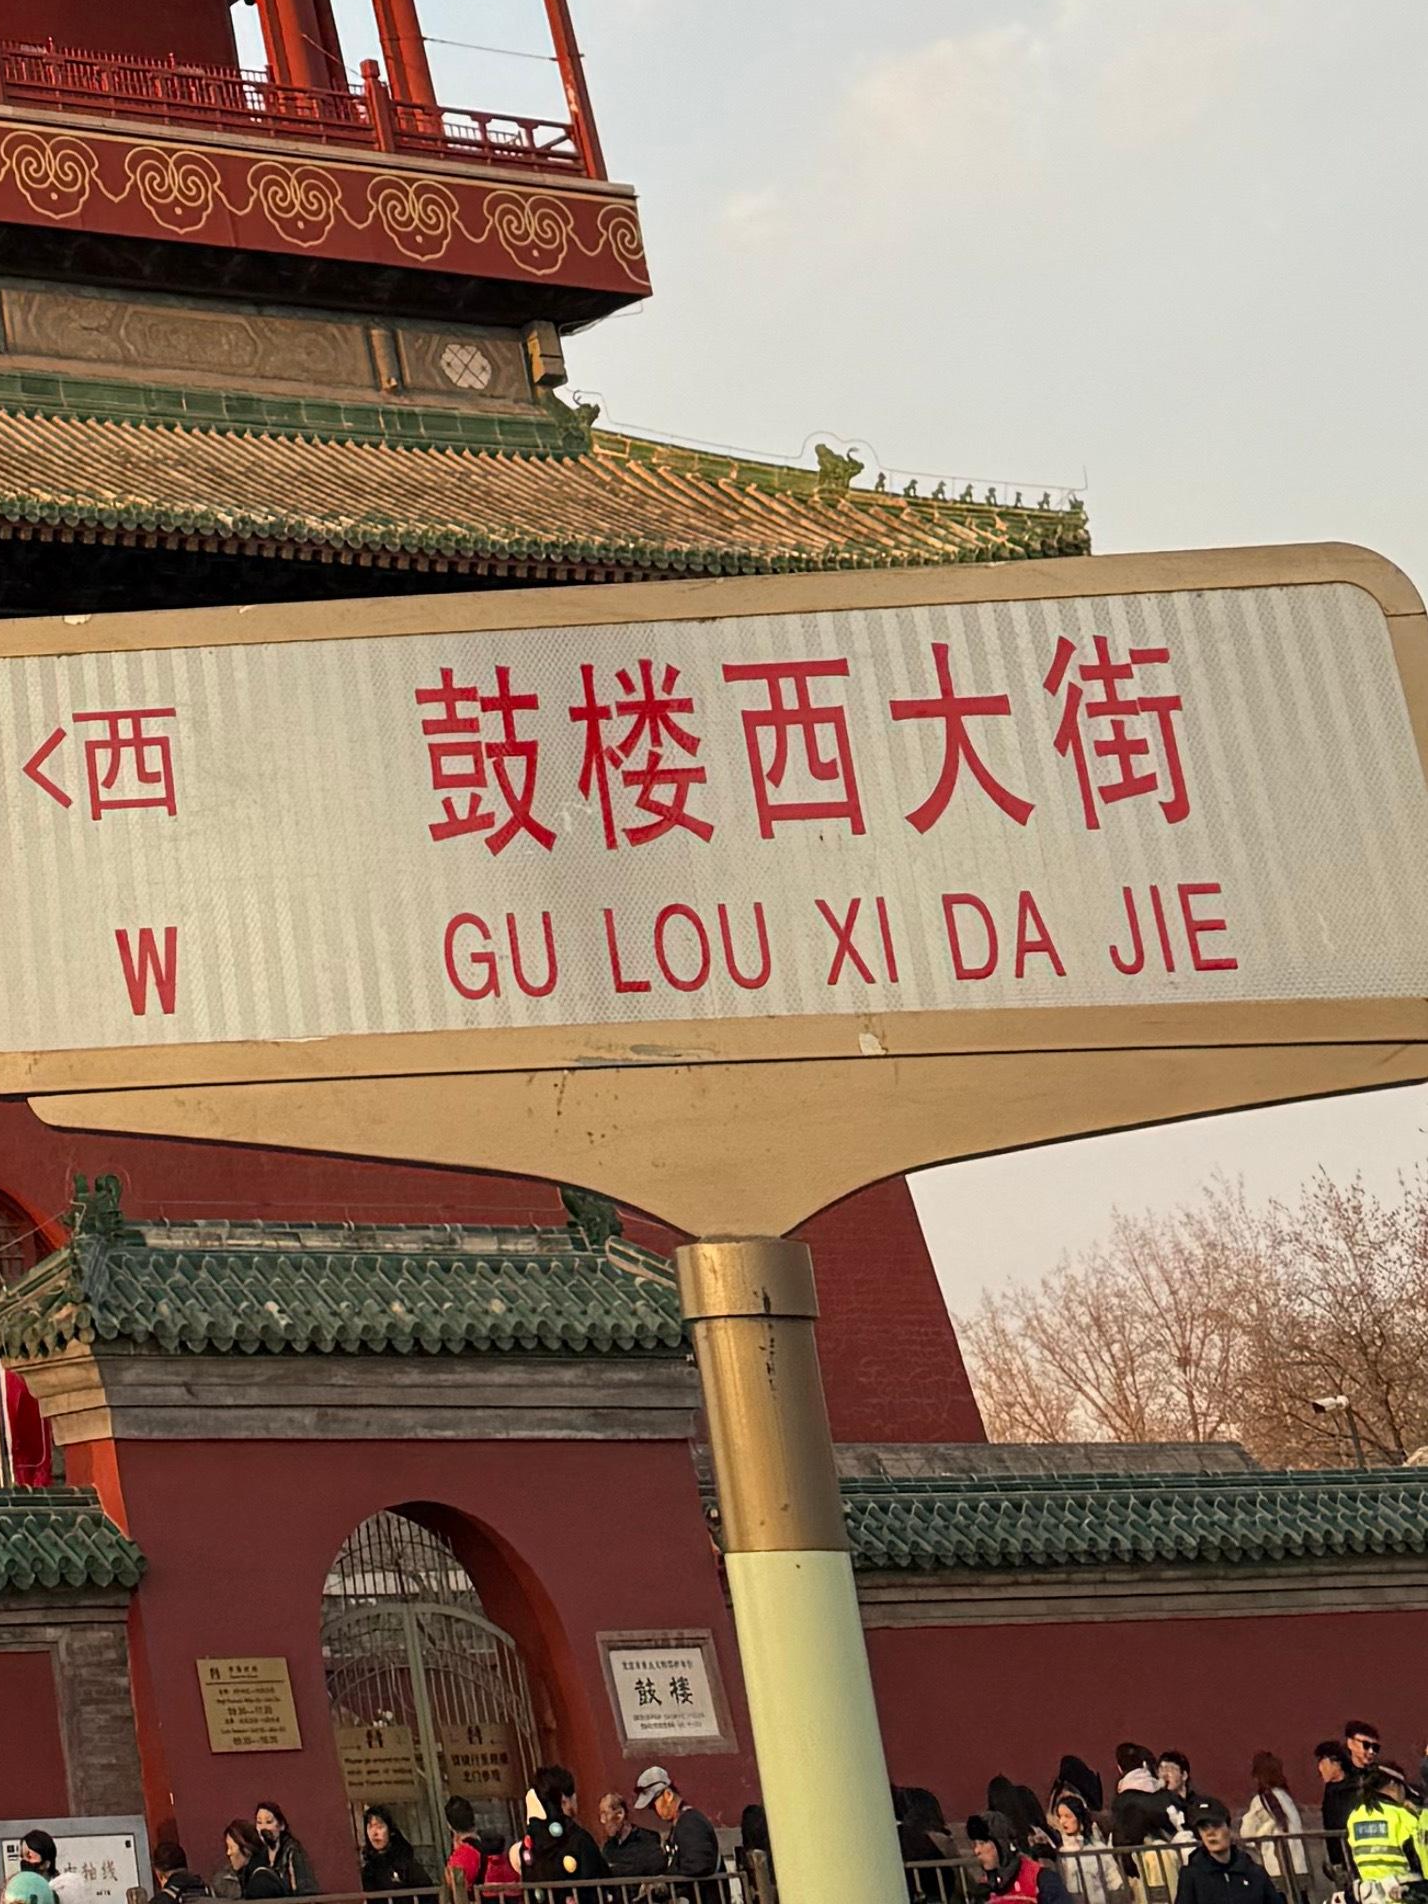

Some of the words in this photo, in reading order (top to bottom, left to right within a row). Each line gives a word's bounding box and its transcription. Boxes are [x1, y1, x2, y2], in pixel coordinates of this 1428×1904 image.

[72, 706, 178, 822] 西
[415, 636, 1190, 855] 鼓楼西大街
[115, 926, 177, 1016] W
[444, 911, 558, 1001] GU
[604, 902, 772, 994] LOU
[816, 896, 899, 986] XI
[943, 890, 1066, 982] DA
[1110, 882, 1240, 976] JIE
